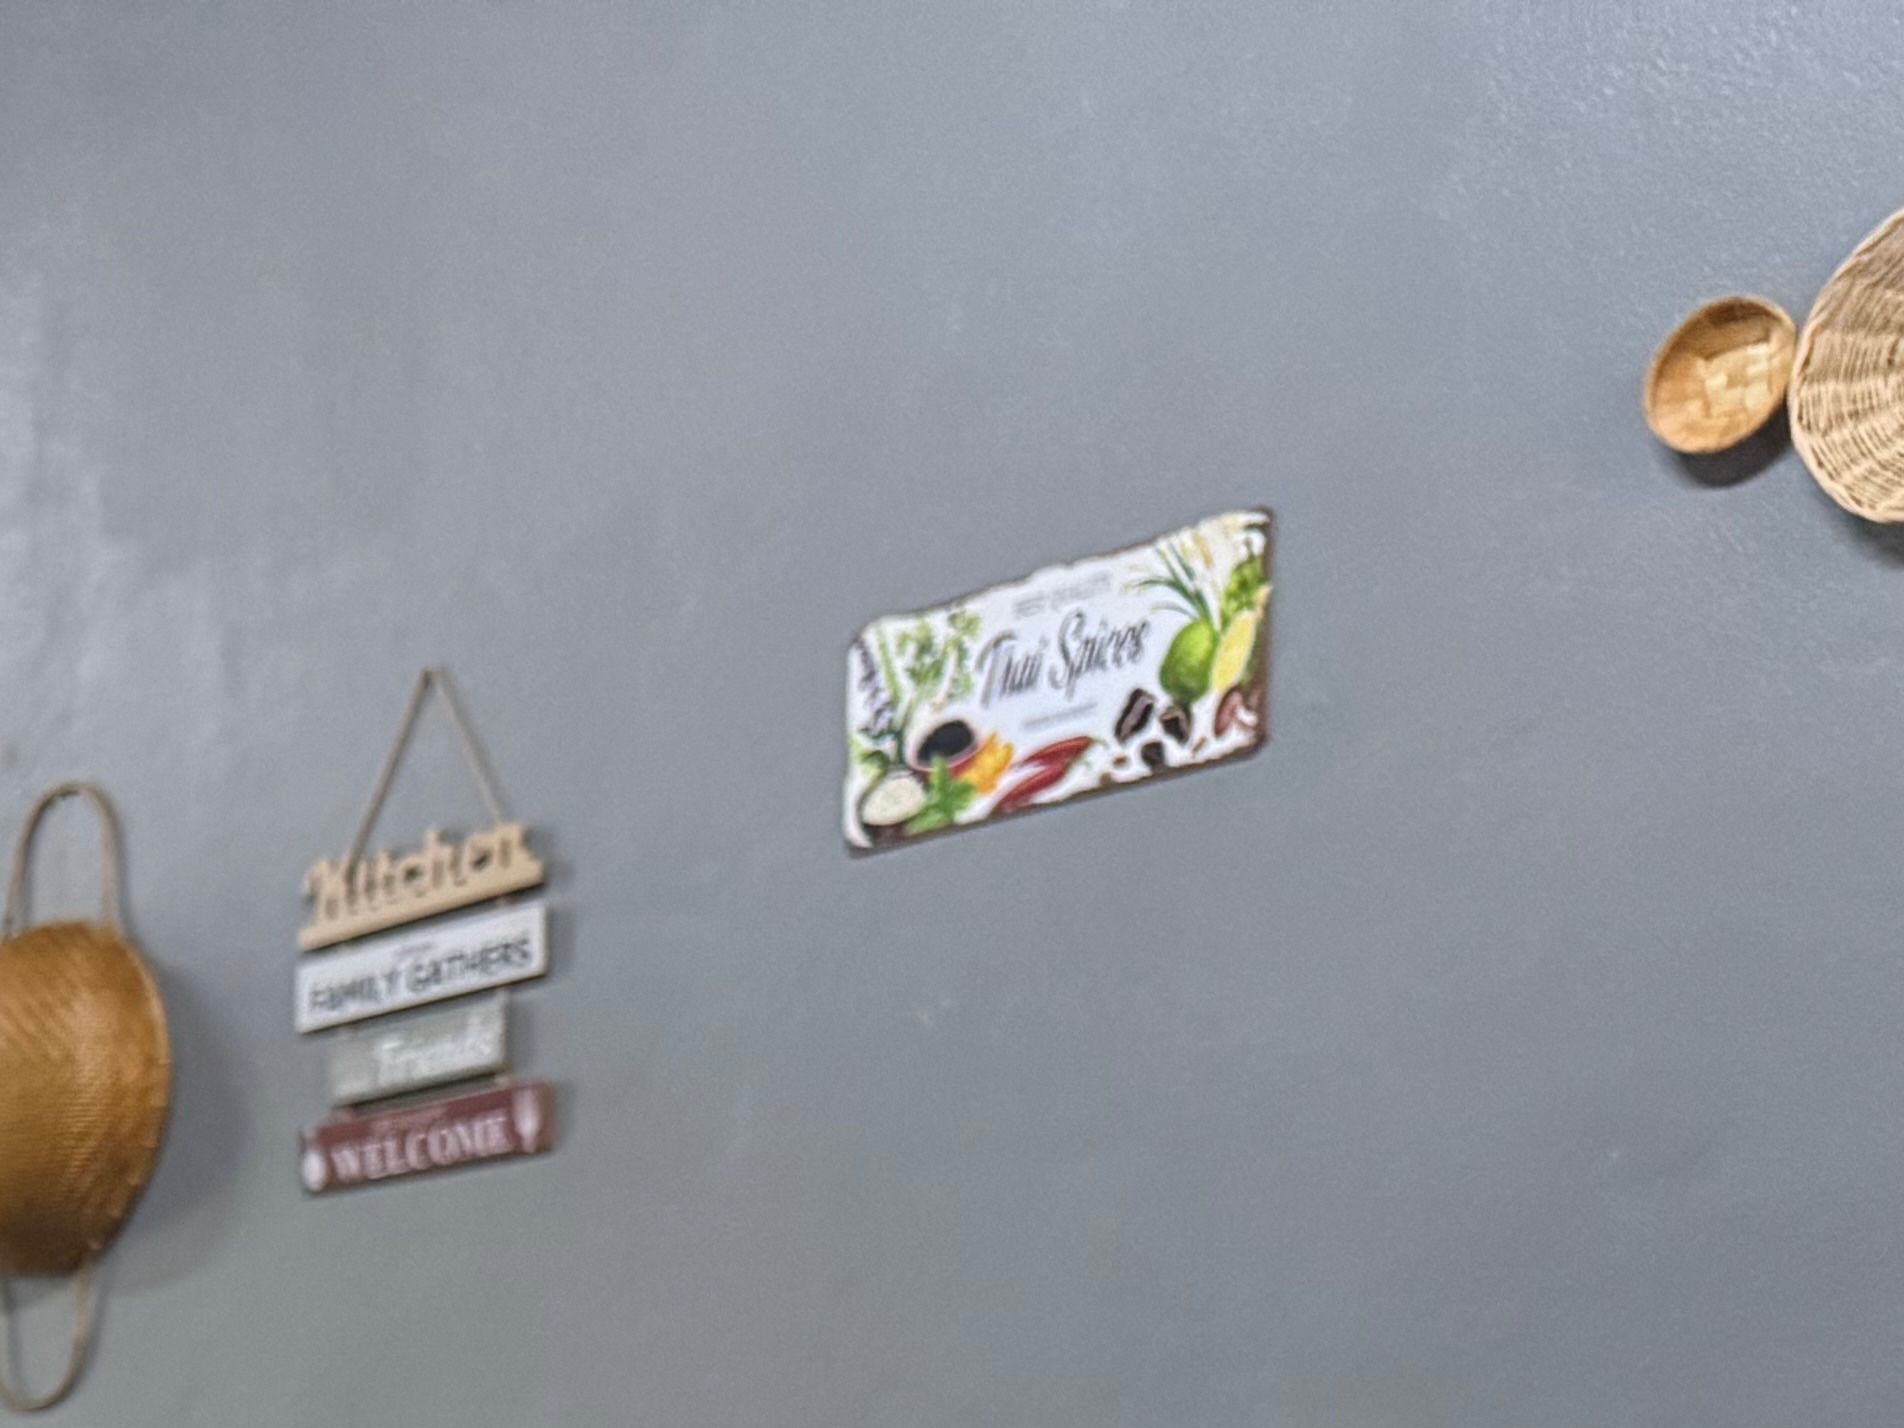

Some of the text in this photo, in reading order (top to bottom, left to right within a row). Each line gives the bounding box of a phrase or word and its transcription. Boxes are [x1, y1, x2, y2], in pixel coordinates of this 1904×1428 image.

[309, 937, 530, 1012] FAMILY GATHERS
[330, 1110, 514, 1182] WELCOME
